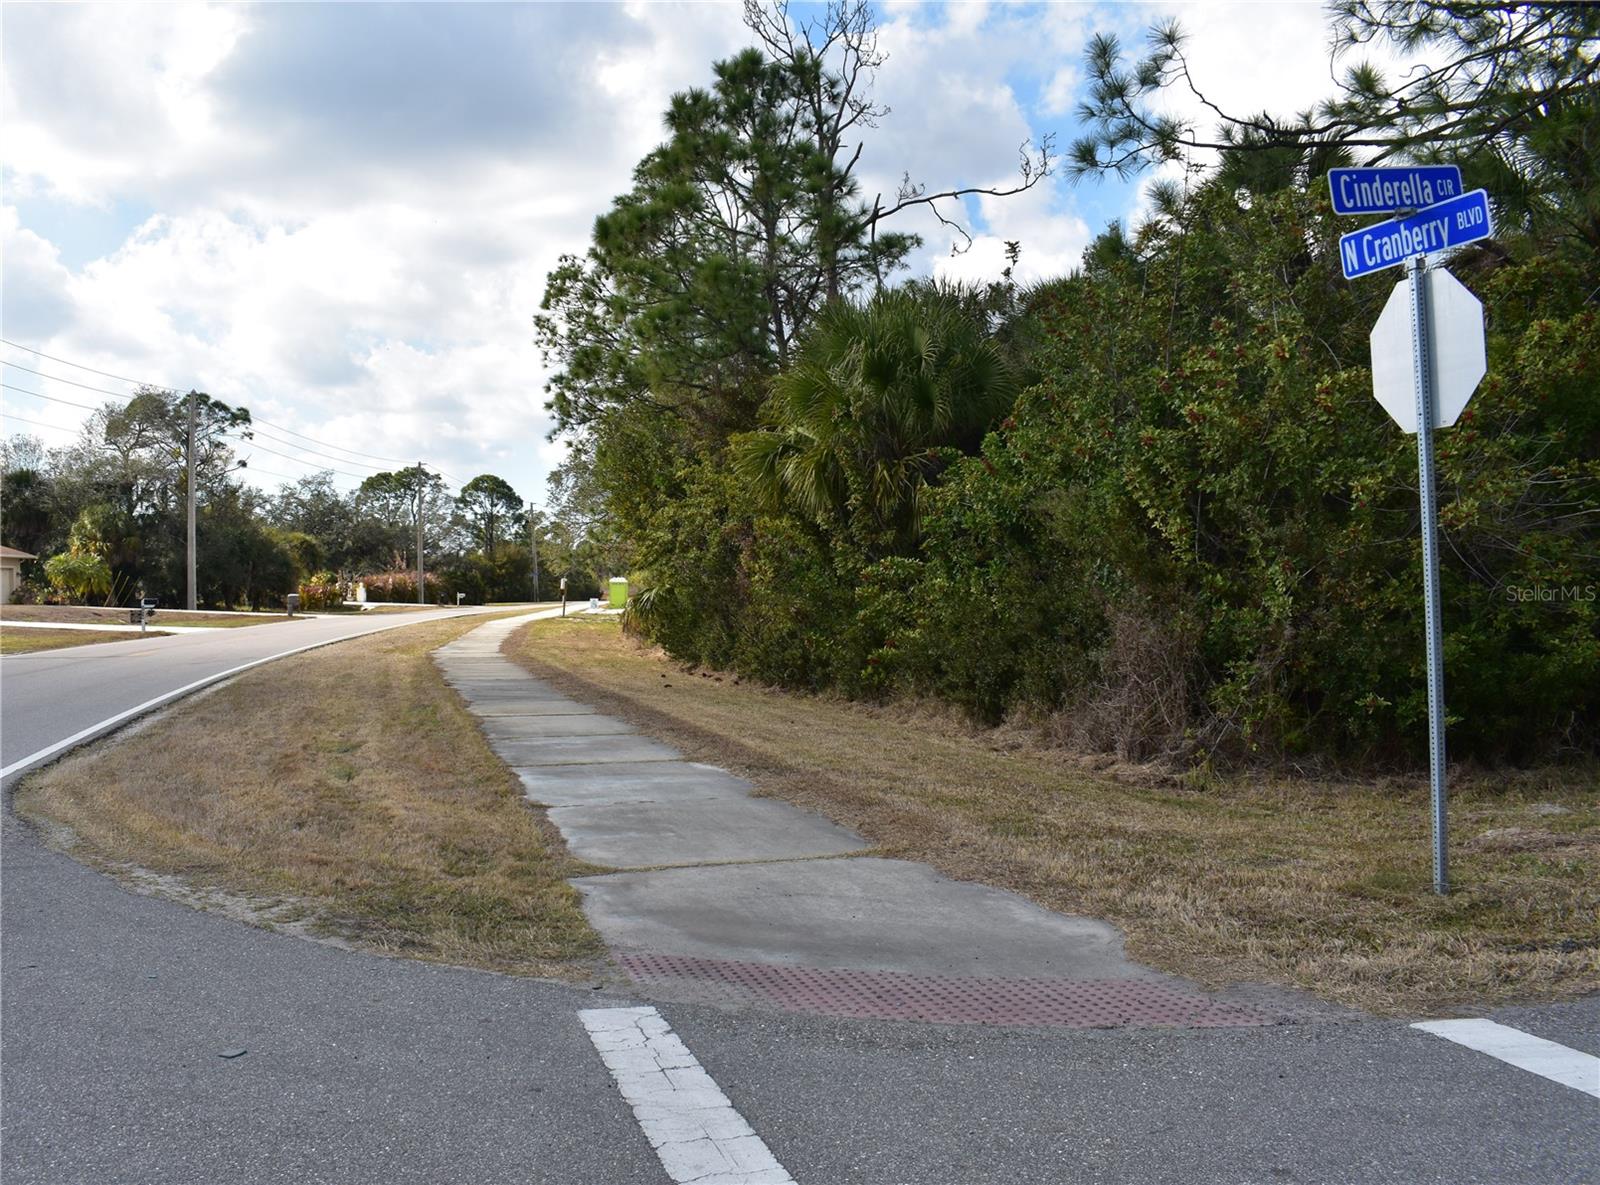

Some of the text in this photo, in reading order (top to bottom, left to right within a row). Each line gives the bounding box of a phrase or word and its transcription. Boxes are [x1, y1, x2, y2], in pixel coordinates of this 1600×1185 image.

[1340, 173, 1455, 208] Cinderella CIR
[1344, 206, 1483, 272] N Cranberry BLVD
